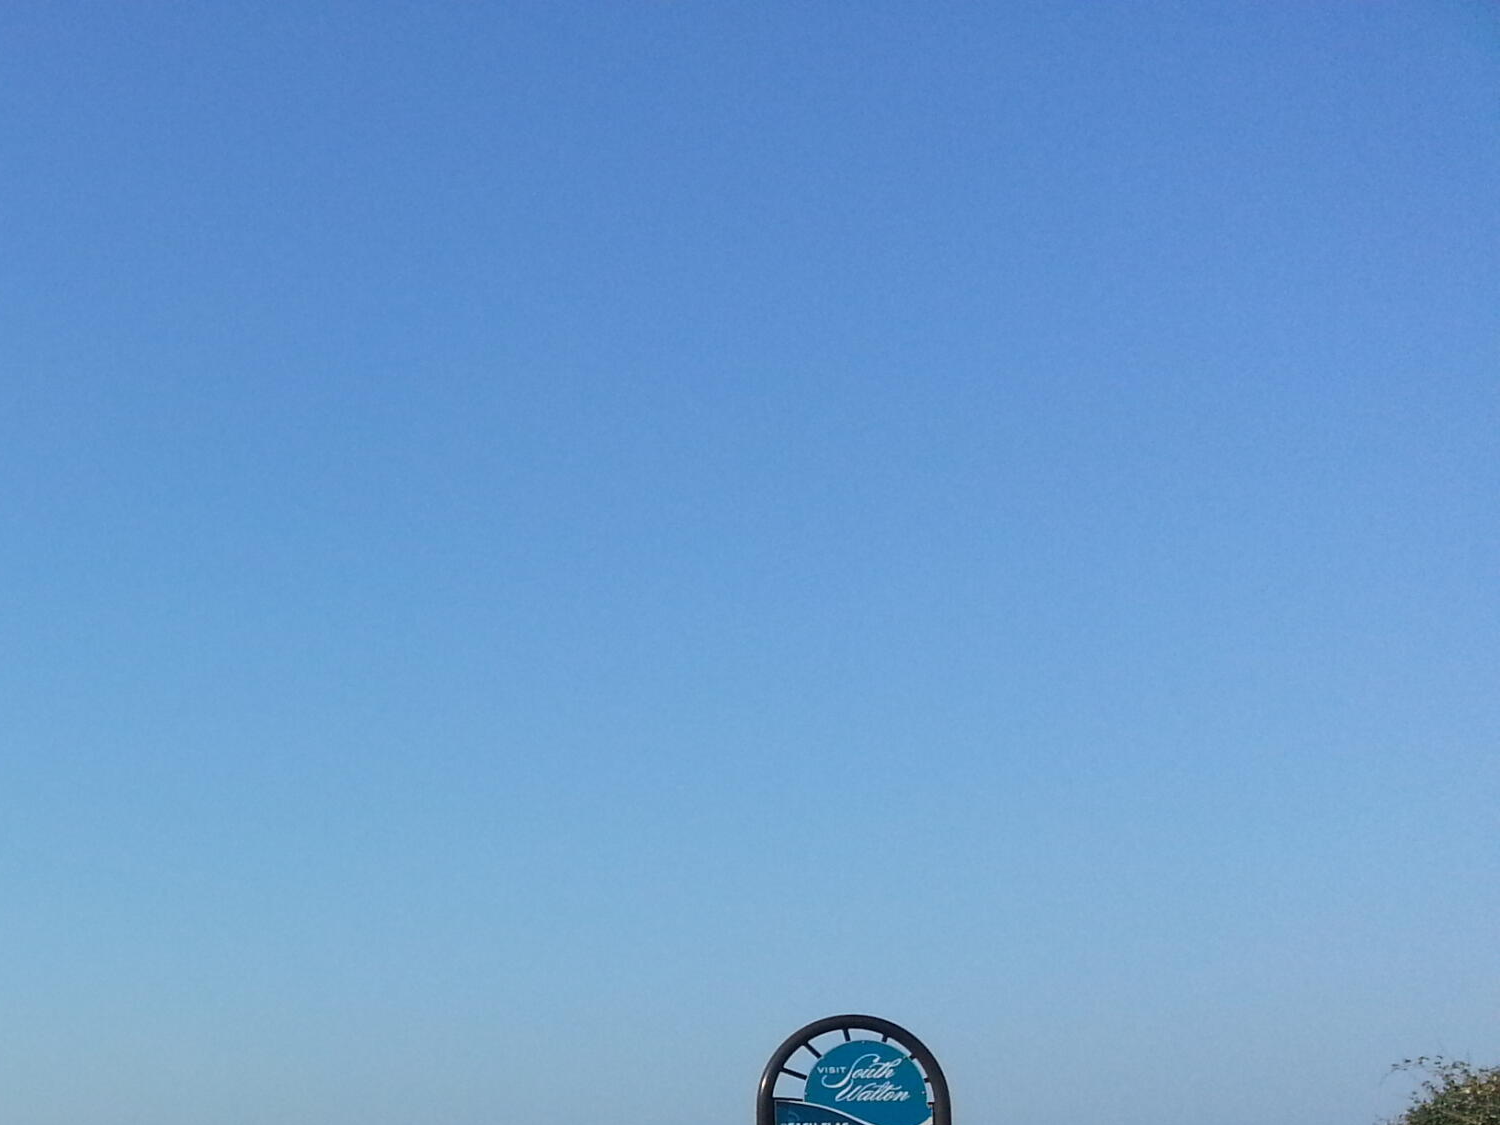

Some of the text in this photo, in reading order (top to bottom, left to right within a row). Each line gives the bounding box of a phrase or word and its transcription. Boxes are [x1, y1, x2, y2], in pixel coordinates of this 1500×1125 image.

[817, 1066, 847, 1074] VISIT
[821, 1053, 902, 1088] South
[835, 1079, 910, 1102] Walton
